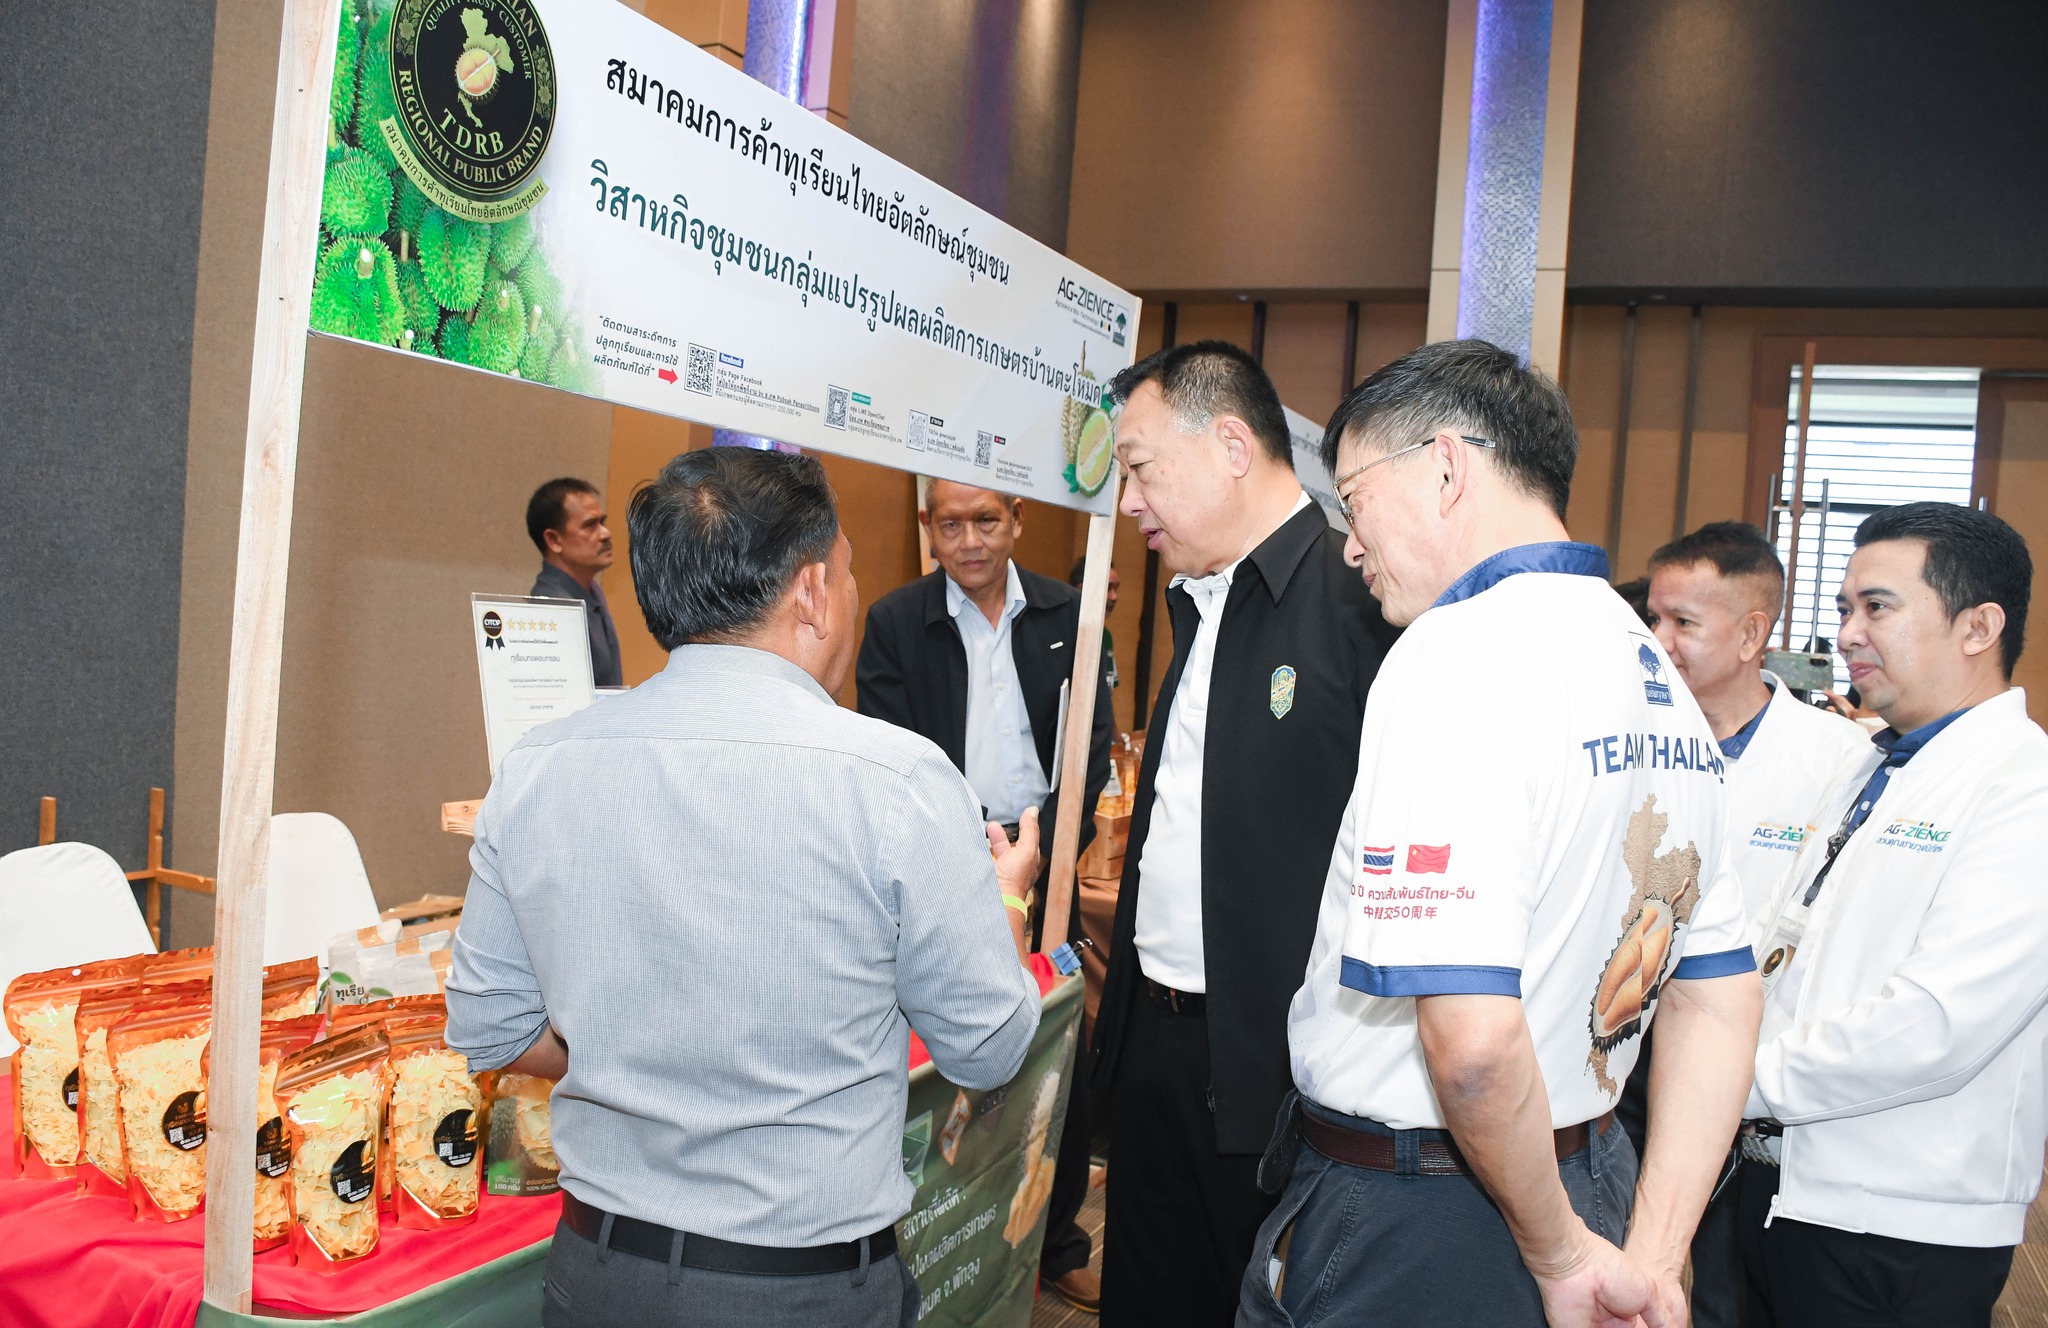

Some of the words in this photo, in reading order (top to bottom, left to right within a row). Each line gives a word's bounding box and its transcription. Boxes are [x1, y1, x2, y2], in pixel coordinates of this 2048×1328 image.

[506, 0, 538, 37] IAN
[498, 11, 532, 80] CUSTOMER
[398, 69, 451, 169] REGIONAL
[453, 158, 507, 184] PUBLIC
[506, 126, 543, 177] BRAND
[385, 124, 544, 219] สมาคมการค้าทุเรียนไทยอัตลักษณ์ชุมชน
[607, 58, 1010, 286] สมาคมการค้าทุเรียนไทยอัตลักษณ์ชุมชน
[590, 158, 1101, 405] วิสาหกิจชุมชนกลุ่มแปรรูปผลผลิตการเกษตรบ้านตะโหมด
[1057, 276, 1114, 321] AG-ZIENCE
[596, 335, 679, 366] ปลูกทุเรียนและการใช้
[728, 371, 739, 381] Page
[740, 375, 762, 386] Facebook
[1582, 733, 1644, 777] TEAM
[1883, 824, 1952, 842] AG-ZIENCE
